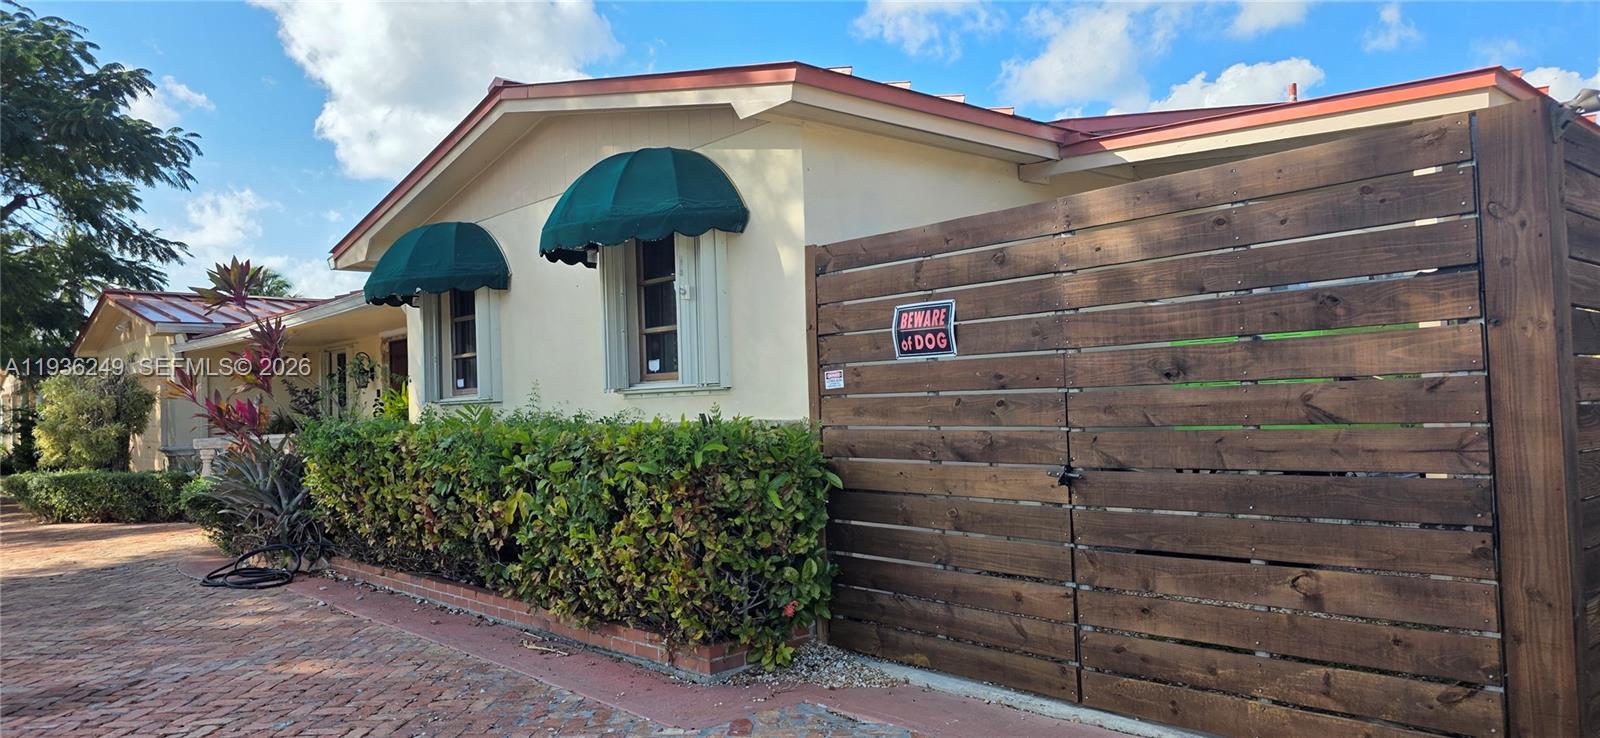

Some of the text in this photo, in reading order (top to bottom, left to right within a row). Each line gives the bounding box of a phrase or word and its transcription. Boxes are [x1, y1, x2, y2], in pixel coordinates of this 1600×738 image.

[900, 308, 946, 329] BEWARE
[901, 332, 947, 351] of DOG
